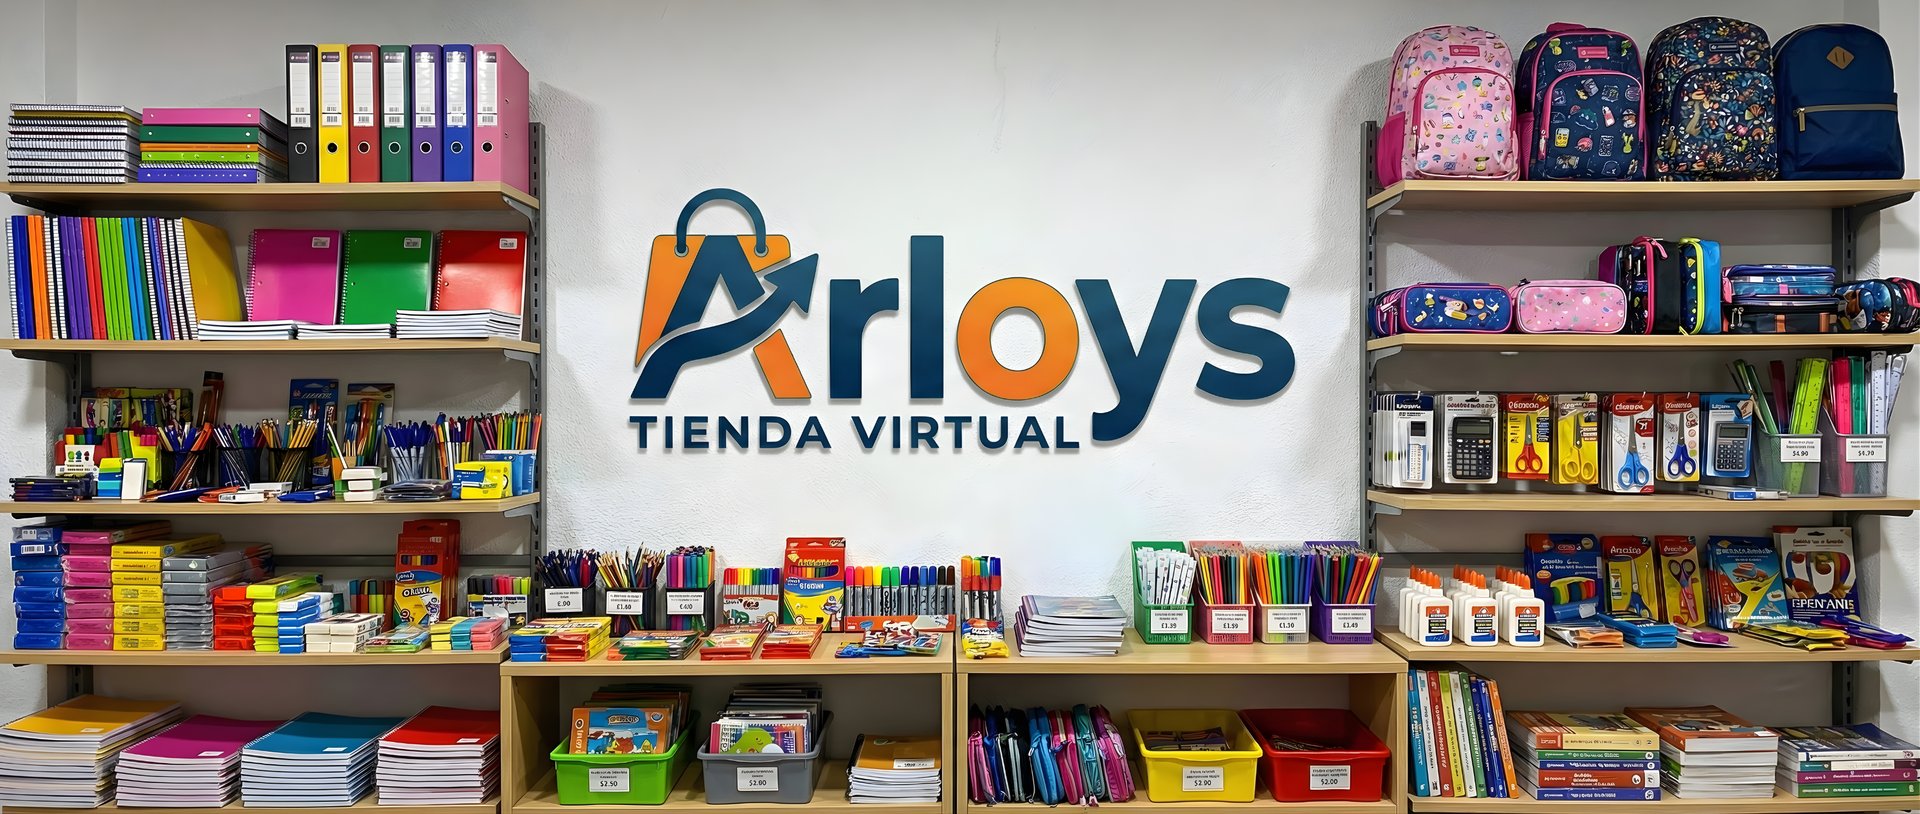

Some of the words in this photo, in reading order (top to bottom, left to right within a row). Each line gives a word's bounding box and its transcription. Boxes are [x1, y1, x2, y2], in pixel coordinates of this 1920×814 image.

[629, 234, 1296, 442] Arloys
[629, 415, 832, 450] TIENDA
[851, 415, 1081, 450] VIRTUAL
